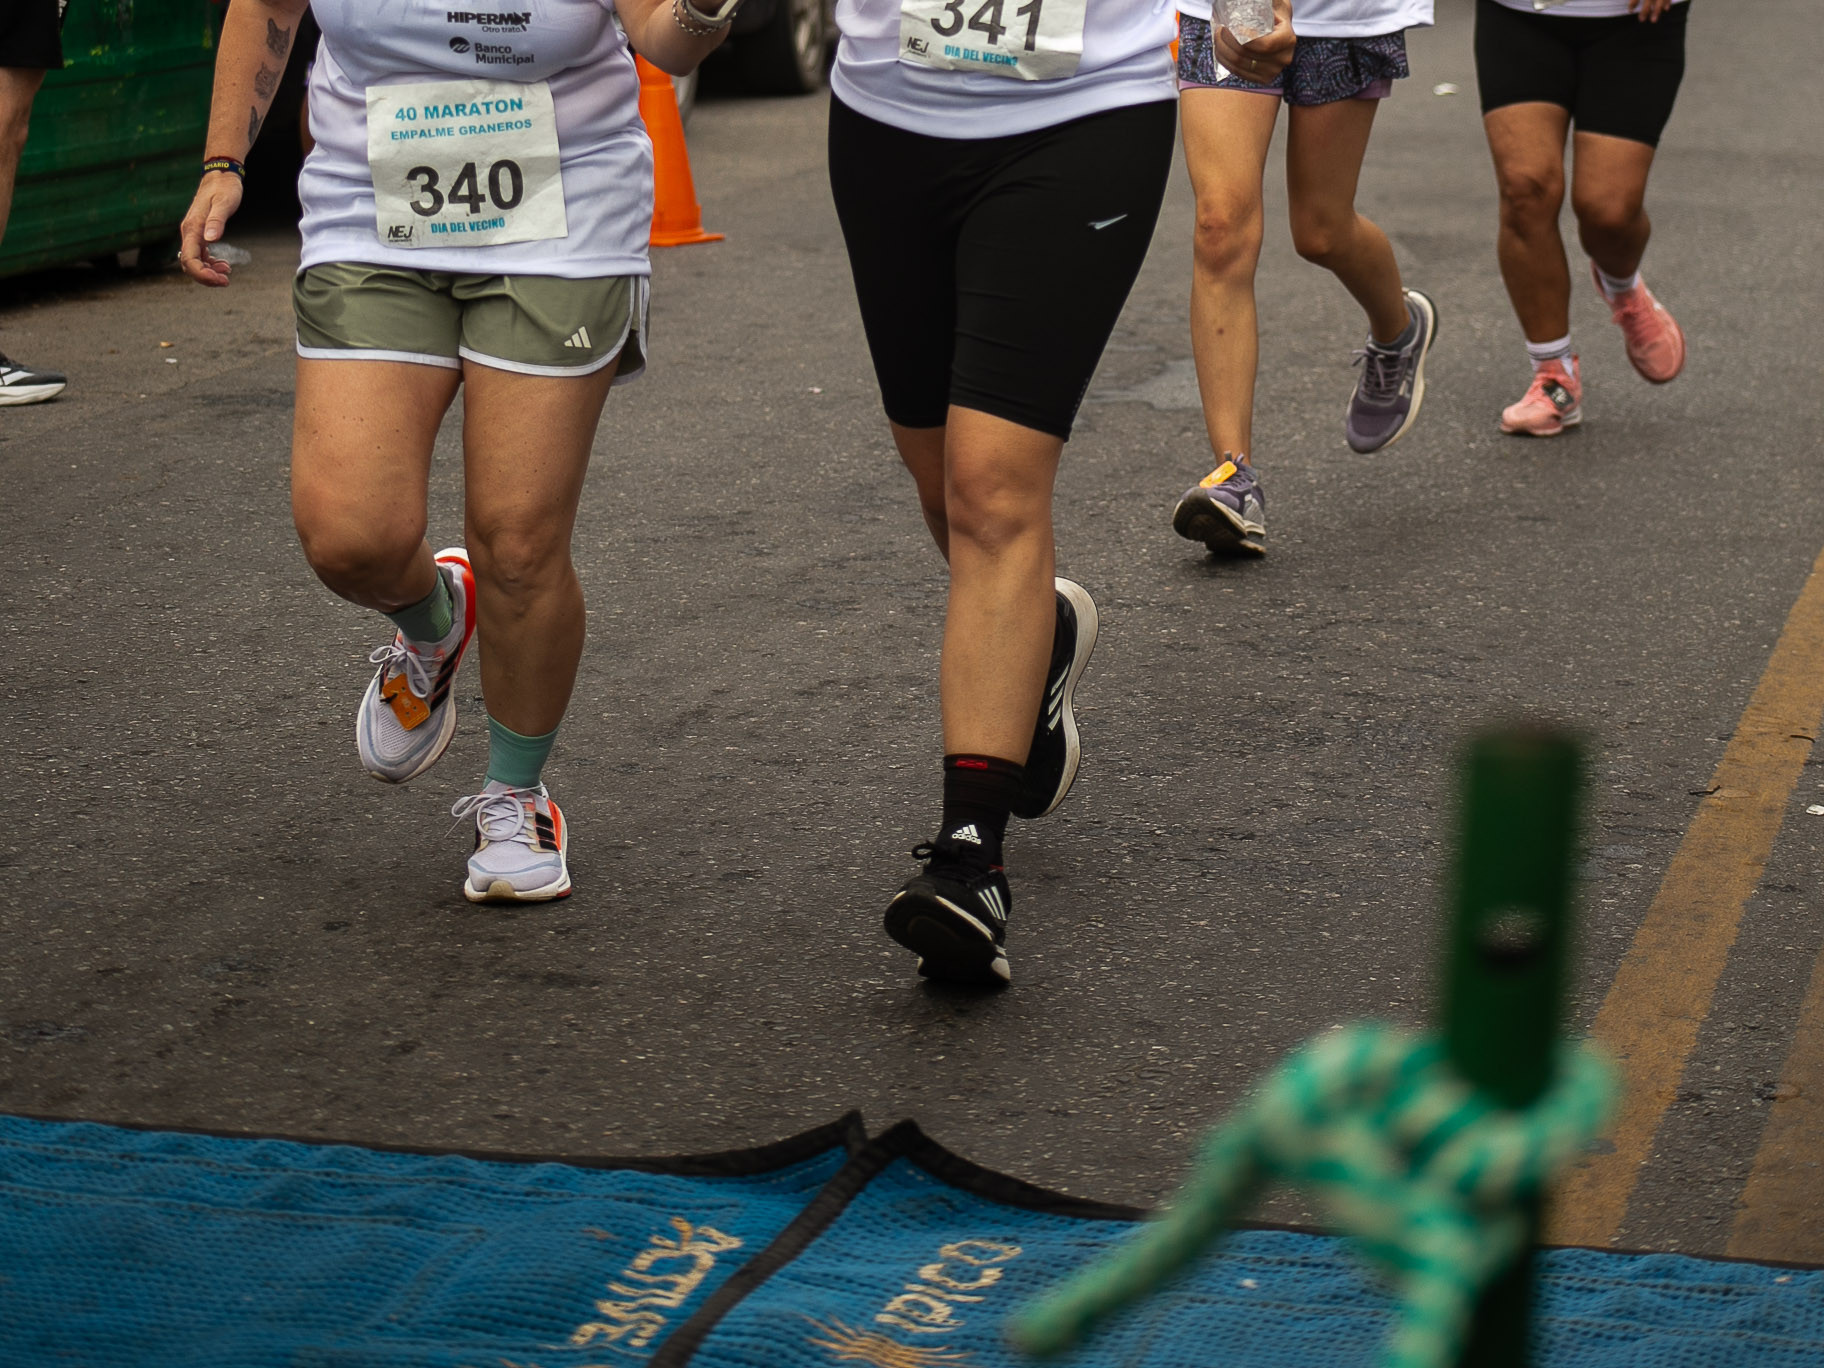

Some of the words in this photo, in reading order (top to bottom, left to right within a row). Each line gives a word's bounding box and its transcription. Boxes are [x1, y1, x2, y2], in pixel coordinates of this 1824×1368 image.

[482, 25, 501, 34] Otro
[474, 42, 512, 54] Banco
[907, 36, 930, 54] NEJ
[475, 53, 535, 66] Municipal
[944, 44, 961, 58] DIA
[963, 48, 980, 62] DEL
[982, 51, 1019, 67] VECINO
[395, 106, 417, 122] 40
[424, 97, 524, 121] MARATON
[391, 126, 455, 141] EMPALME
[459, 119, 533, 136] GRANEROS
[405, 159, 524, 217] 340
[387, 225, 414, 239] NEJ
[430, 222, 449, 235] DIA
[450, 220, 468, 233] DEL
[469, 217, 506, 232] VECINO
[951, 833, 982, 845] adidas
